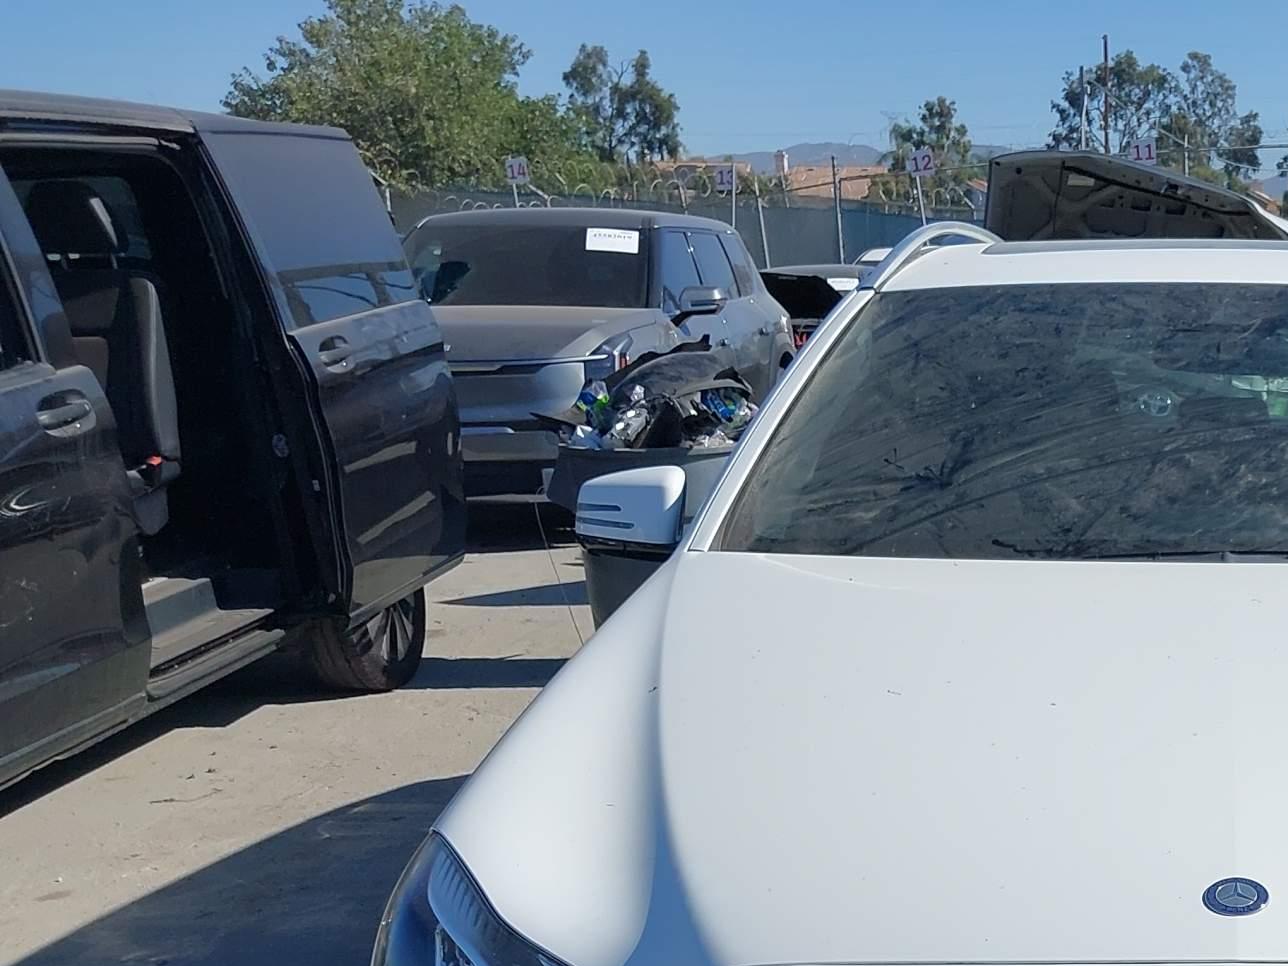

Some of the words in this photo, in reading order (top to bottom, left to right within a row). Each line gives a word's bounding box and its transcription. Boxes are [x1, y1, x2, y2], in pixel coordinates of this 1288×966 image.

[1133, 143, 1155, 161] 11
[509, 162, 526, 180] 14
[912, 154, 933, 172] 12
